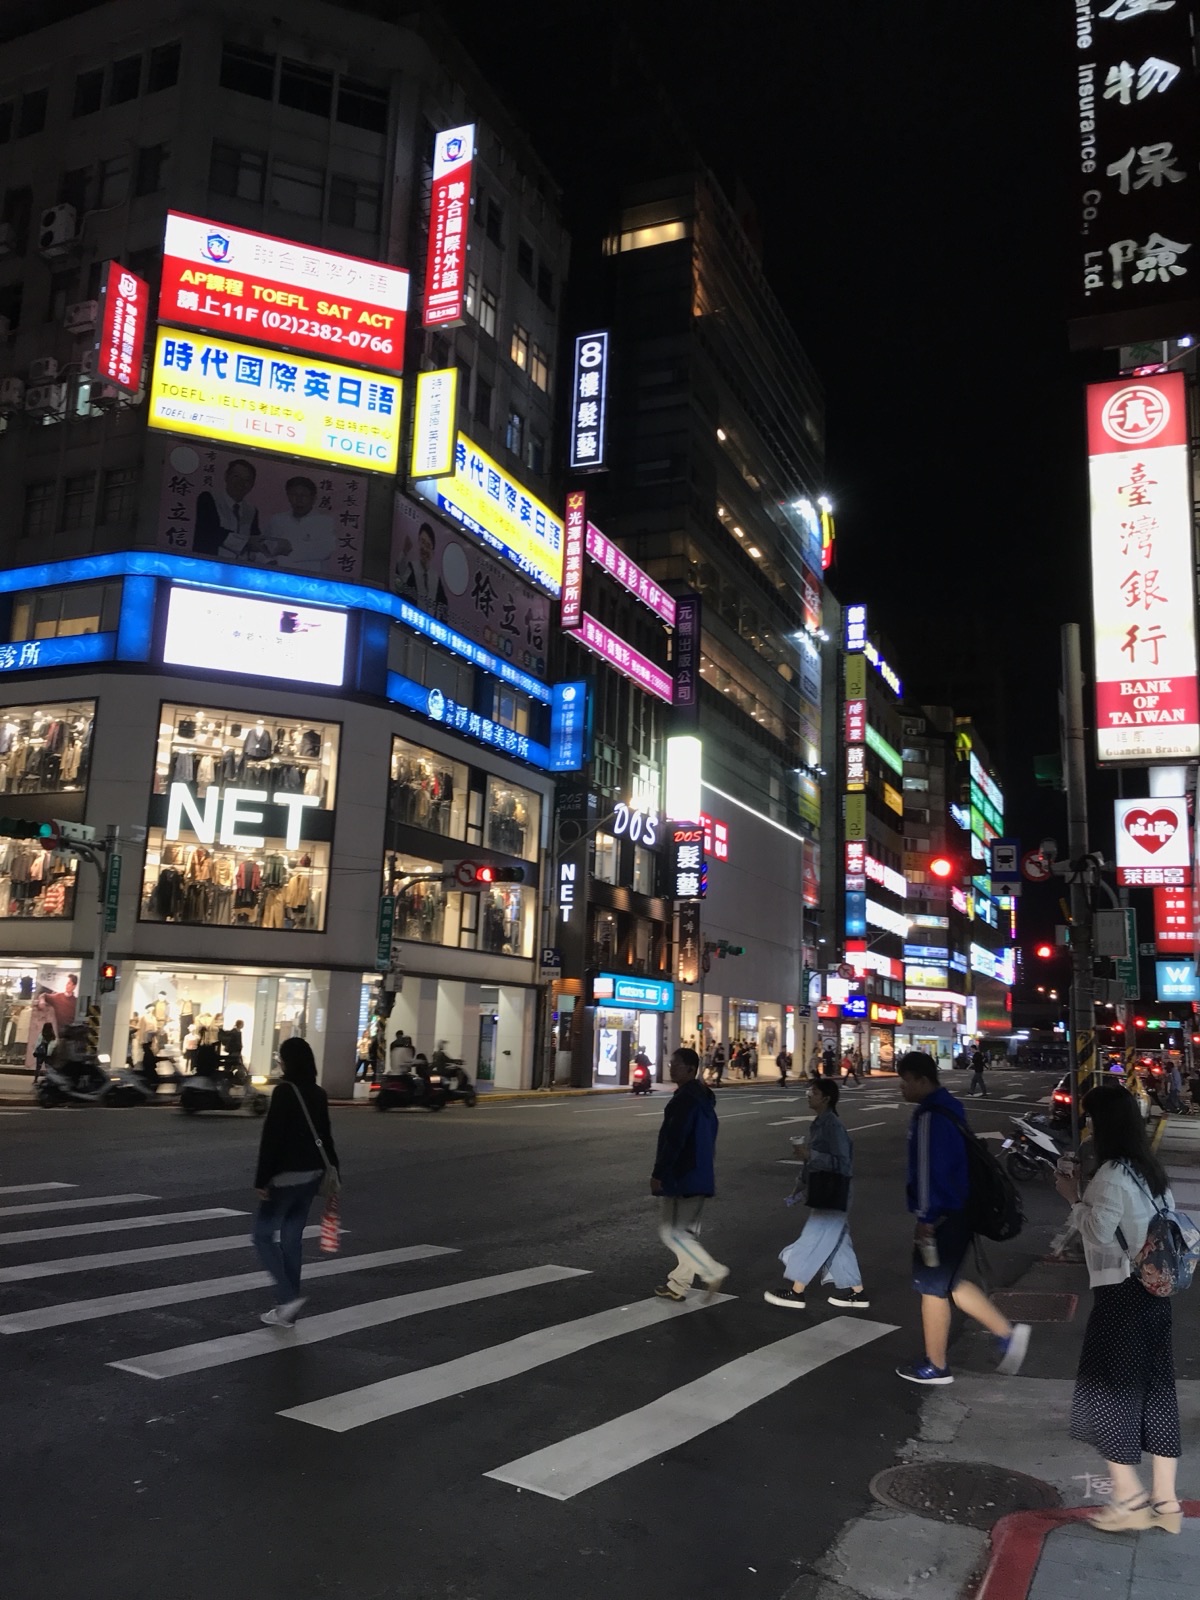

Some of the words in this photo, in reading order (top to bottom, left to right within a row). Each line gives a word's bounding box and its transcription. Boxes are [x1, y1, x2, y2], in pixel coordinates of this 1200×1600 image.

[1078, 63, 1096, 173] Insurance
[441, 182, 465, 289] 聯合國際外語
[180, 269, 243, 297] AP課程
[251, 285, 309, 310] TOEFL
[316, 302, 352, 320] SAT
[358, 310, 394, 329] ACT
[1083, 250, 1104, 297] Ltd.
[177, 289, 259, 322] 請上11F
[261, 309, 393, 354] (02)2382-0766
[163, 338, 396, 415] 時代國際英日語
[576, 341, 602, 458] 8樓髮藝
[245, 417, 296, 438] IELTS
[327, 434, 388, 459] TOEIC
[166, 475, 194, 548] 徐立信
[338, 509, 361, 574] 柯文哲
[565, 511, 582, 601] 光澤晶漾診所
[1117, 461, 1170, 667] 臺灣銀行
[471, 570, 546, 652] 徐立信
[563, 603, 578, 614] 6F
[1120, 679, 1173, 696] BANK
[1133, 695, 1160, 710] OF
[1108, 708, 1186, 725] TAIWAN
[166, 781, 321, 851] NET
[613, 801, 659, 846] DOS
[673, 830, 703, 843] DOS
[1129, 818, 1176, 843] Hi-Life
[560, 864, 575, 922] NET
[676, 845, 700, 896] 髮藝
[1123, 868, 1185, 884] 萊爾富
[1165, 966, 1190, 984] W
